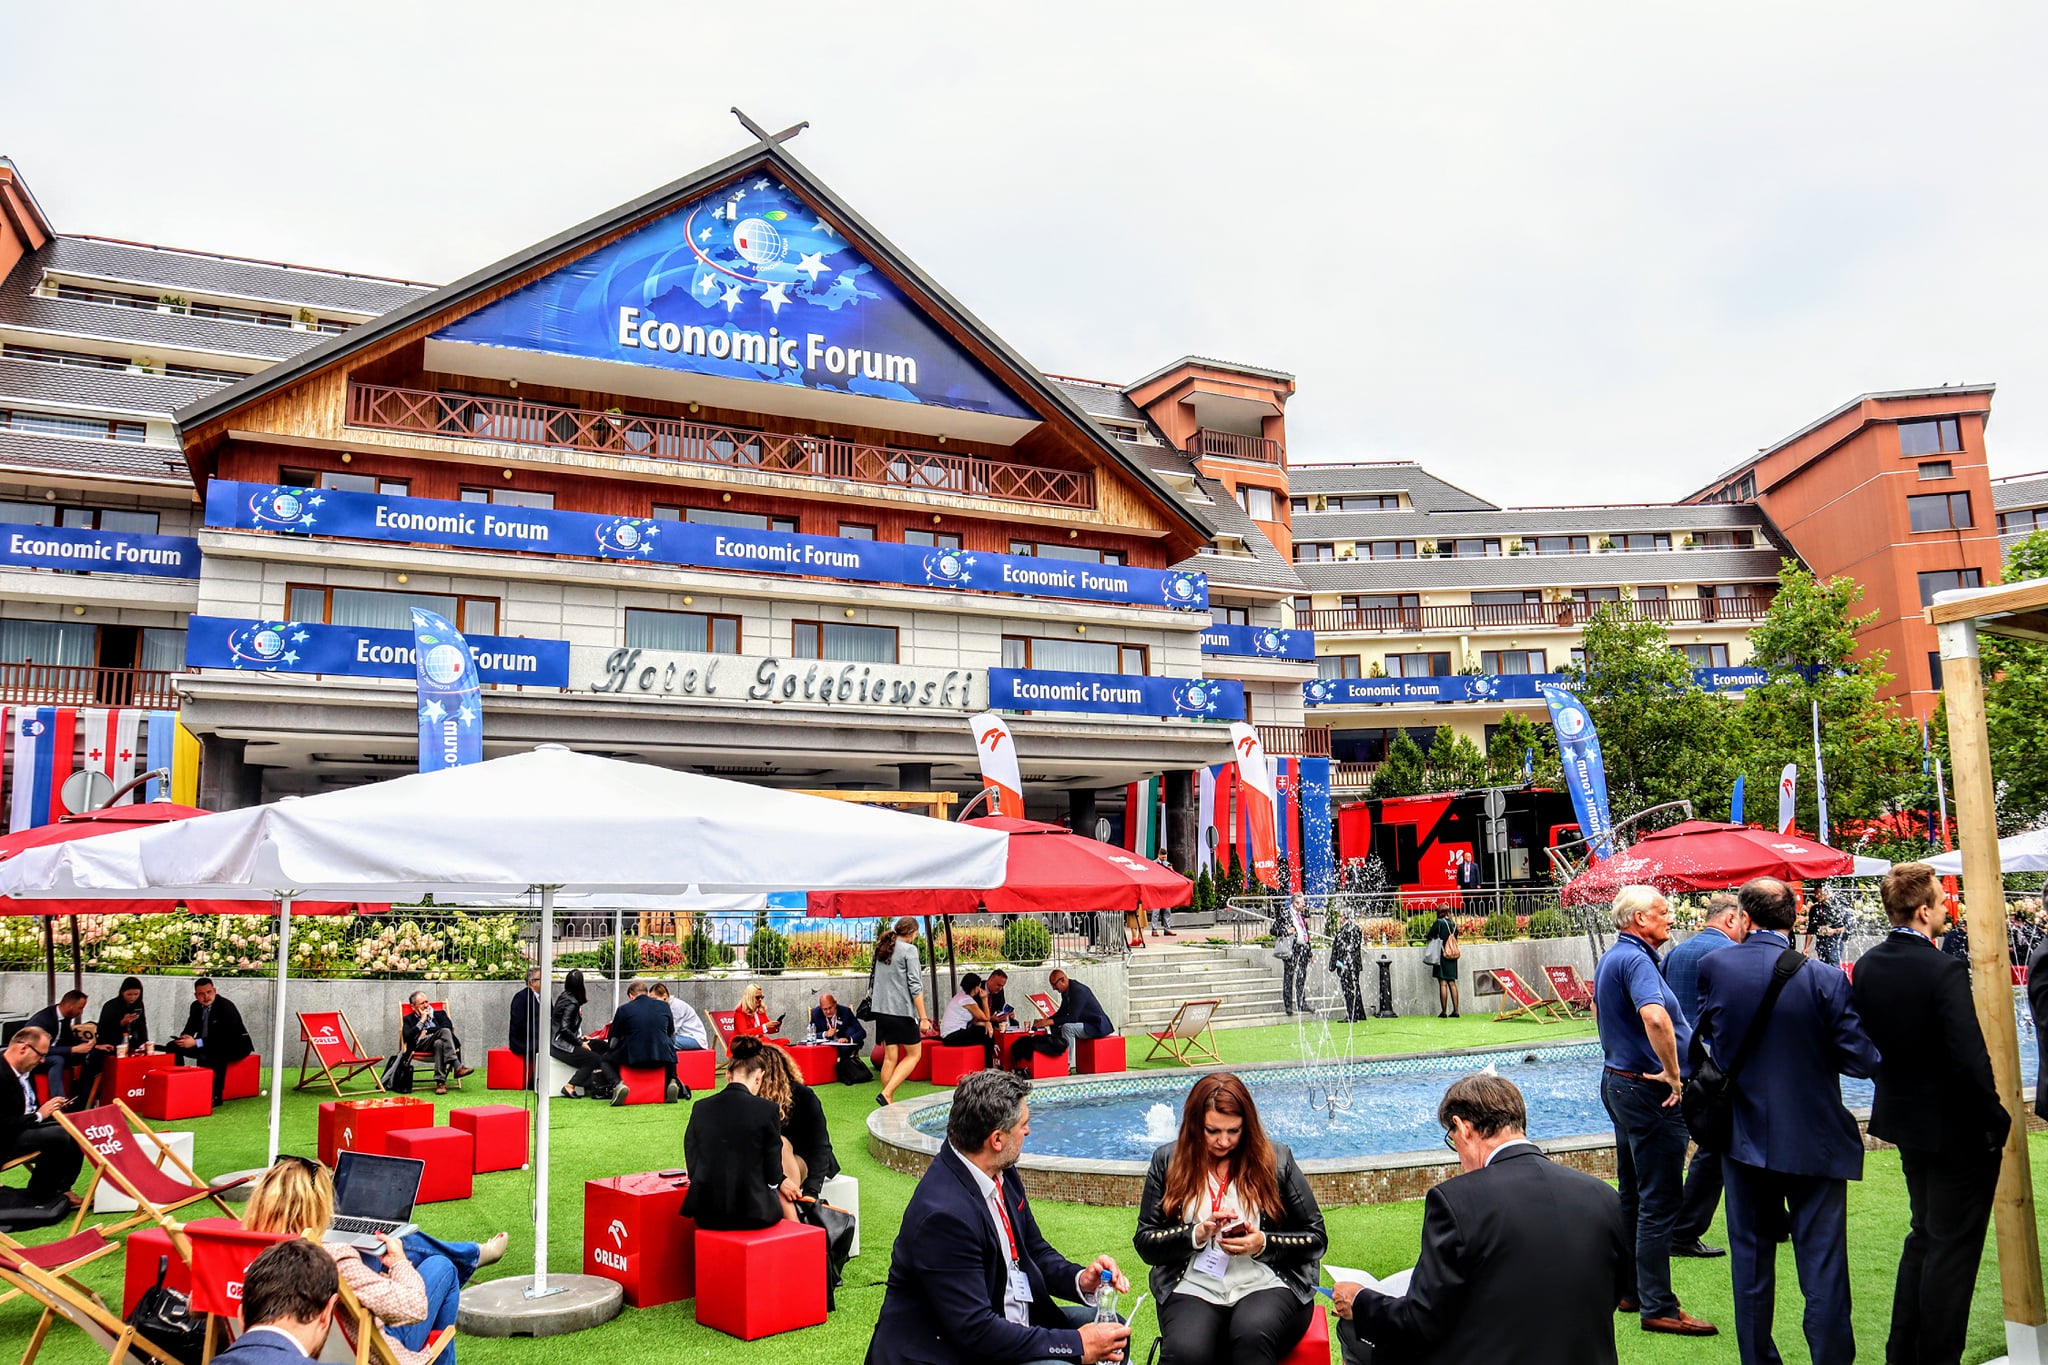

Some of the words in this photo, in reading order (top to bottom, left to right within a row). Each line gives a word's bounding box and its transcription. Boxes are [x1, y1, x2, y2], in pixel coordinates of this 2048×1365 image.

[619, 306, 799, 369] Economic
[806, 333, 917, 384] Forum
[375, 505, 476, 535] Economic
[483, 515, 549, 541] Forum
[10, 534, 112, 561] Economic
[115, 541, 182, 566] Forum
[715, 536, 801, 563] Economic
[804, 544, 860, 569] Forum
[1003, 563, 1076, 588] Economic
[1081, 571, 1128, 593] Forum
[1200, 633, 1230, 646] orum
[357, 639, 416, 665] Econ
[470, 646, 537, 672] Forum
[590, 648, 720, 694] Hotel
[1712, 672, 1764, 686] Economic
[1013, 678, 1089, 701] Economic
[1091, 682, 1142, 704] Forum
[1348, 684, 1401, 697] Economic
[1404, 683, 1440, 696] Forum
[313, 1036, 338, 1044] ORLEN
[84, 1124, 115, 1141] stop
[93, 1136, 124, 1155] cafe
[594, 1247, 628, 1272] ORLEN
